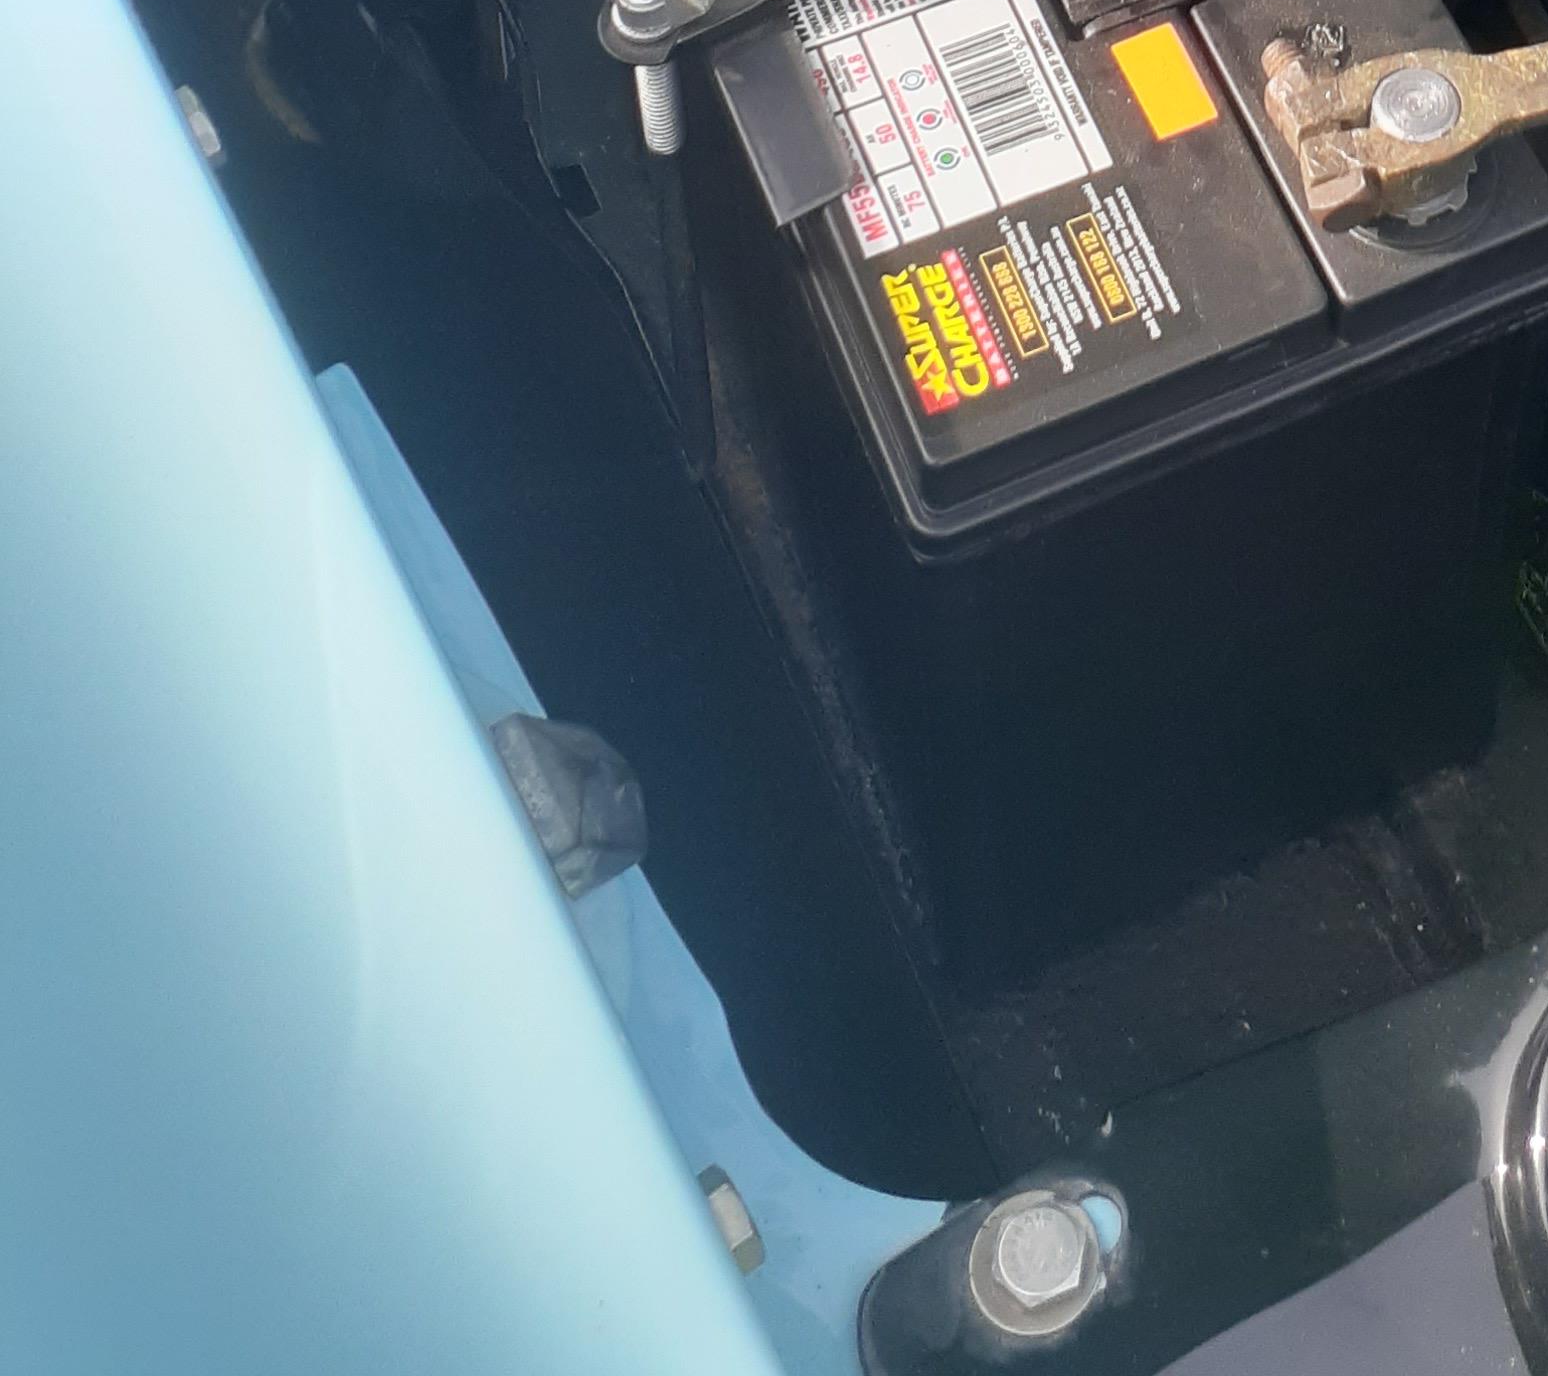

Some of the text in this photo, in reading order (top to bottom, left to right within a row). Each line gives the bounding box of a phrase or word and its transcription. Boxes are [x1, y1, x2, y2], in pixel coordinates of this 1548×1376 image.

[1006, 28, 1034, 74] 000604
[847, 53, 870, 83] 14.8
[1029, 79, 1059, 127] 324503
[875, 124, 895, 143] 50
[903, 190, 924, 212] 75
[1079, 228, 1099, 251] 122
[883, 272, 945, 378] SUPER
[917, 264, 987, 394] CHARGE
[1012, 308, 1036, 339] 1300
